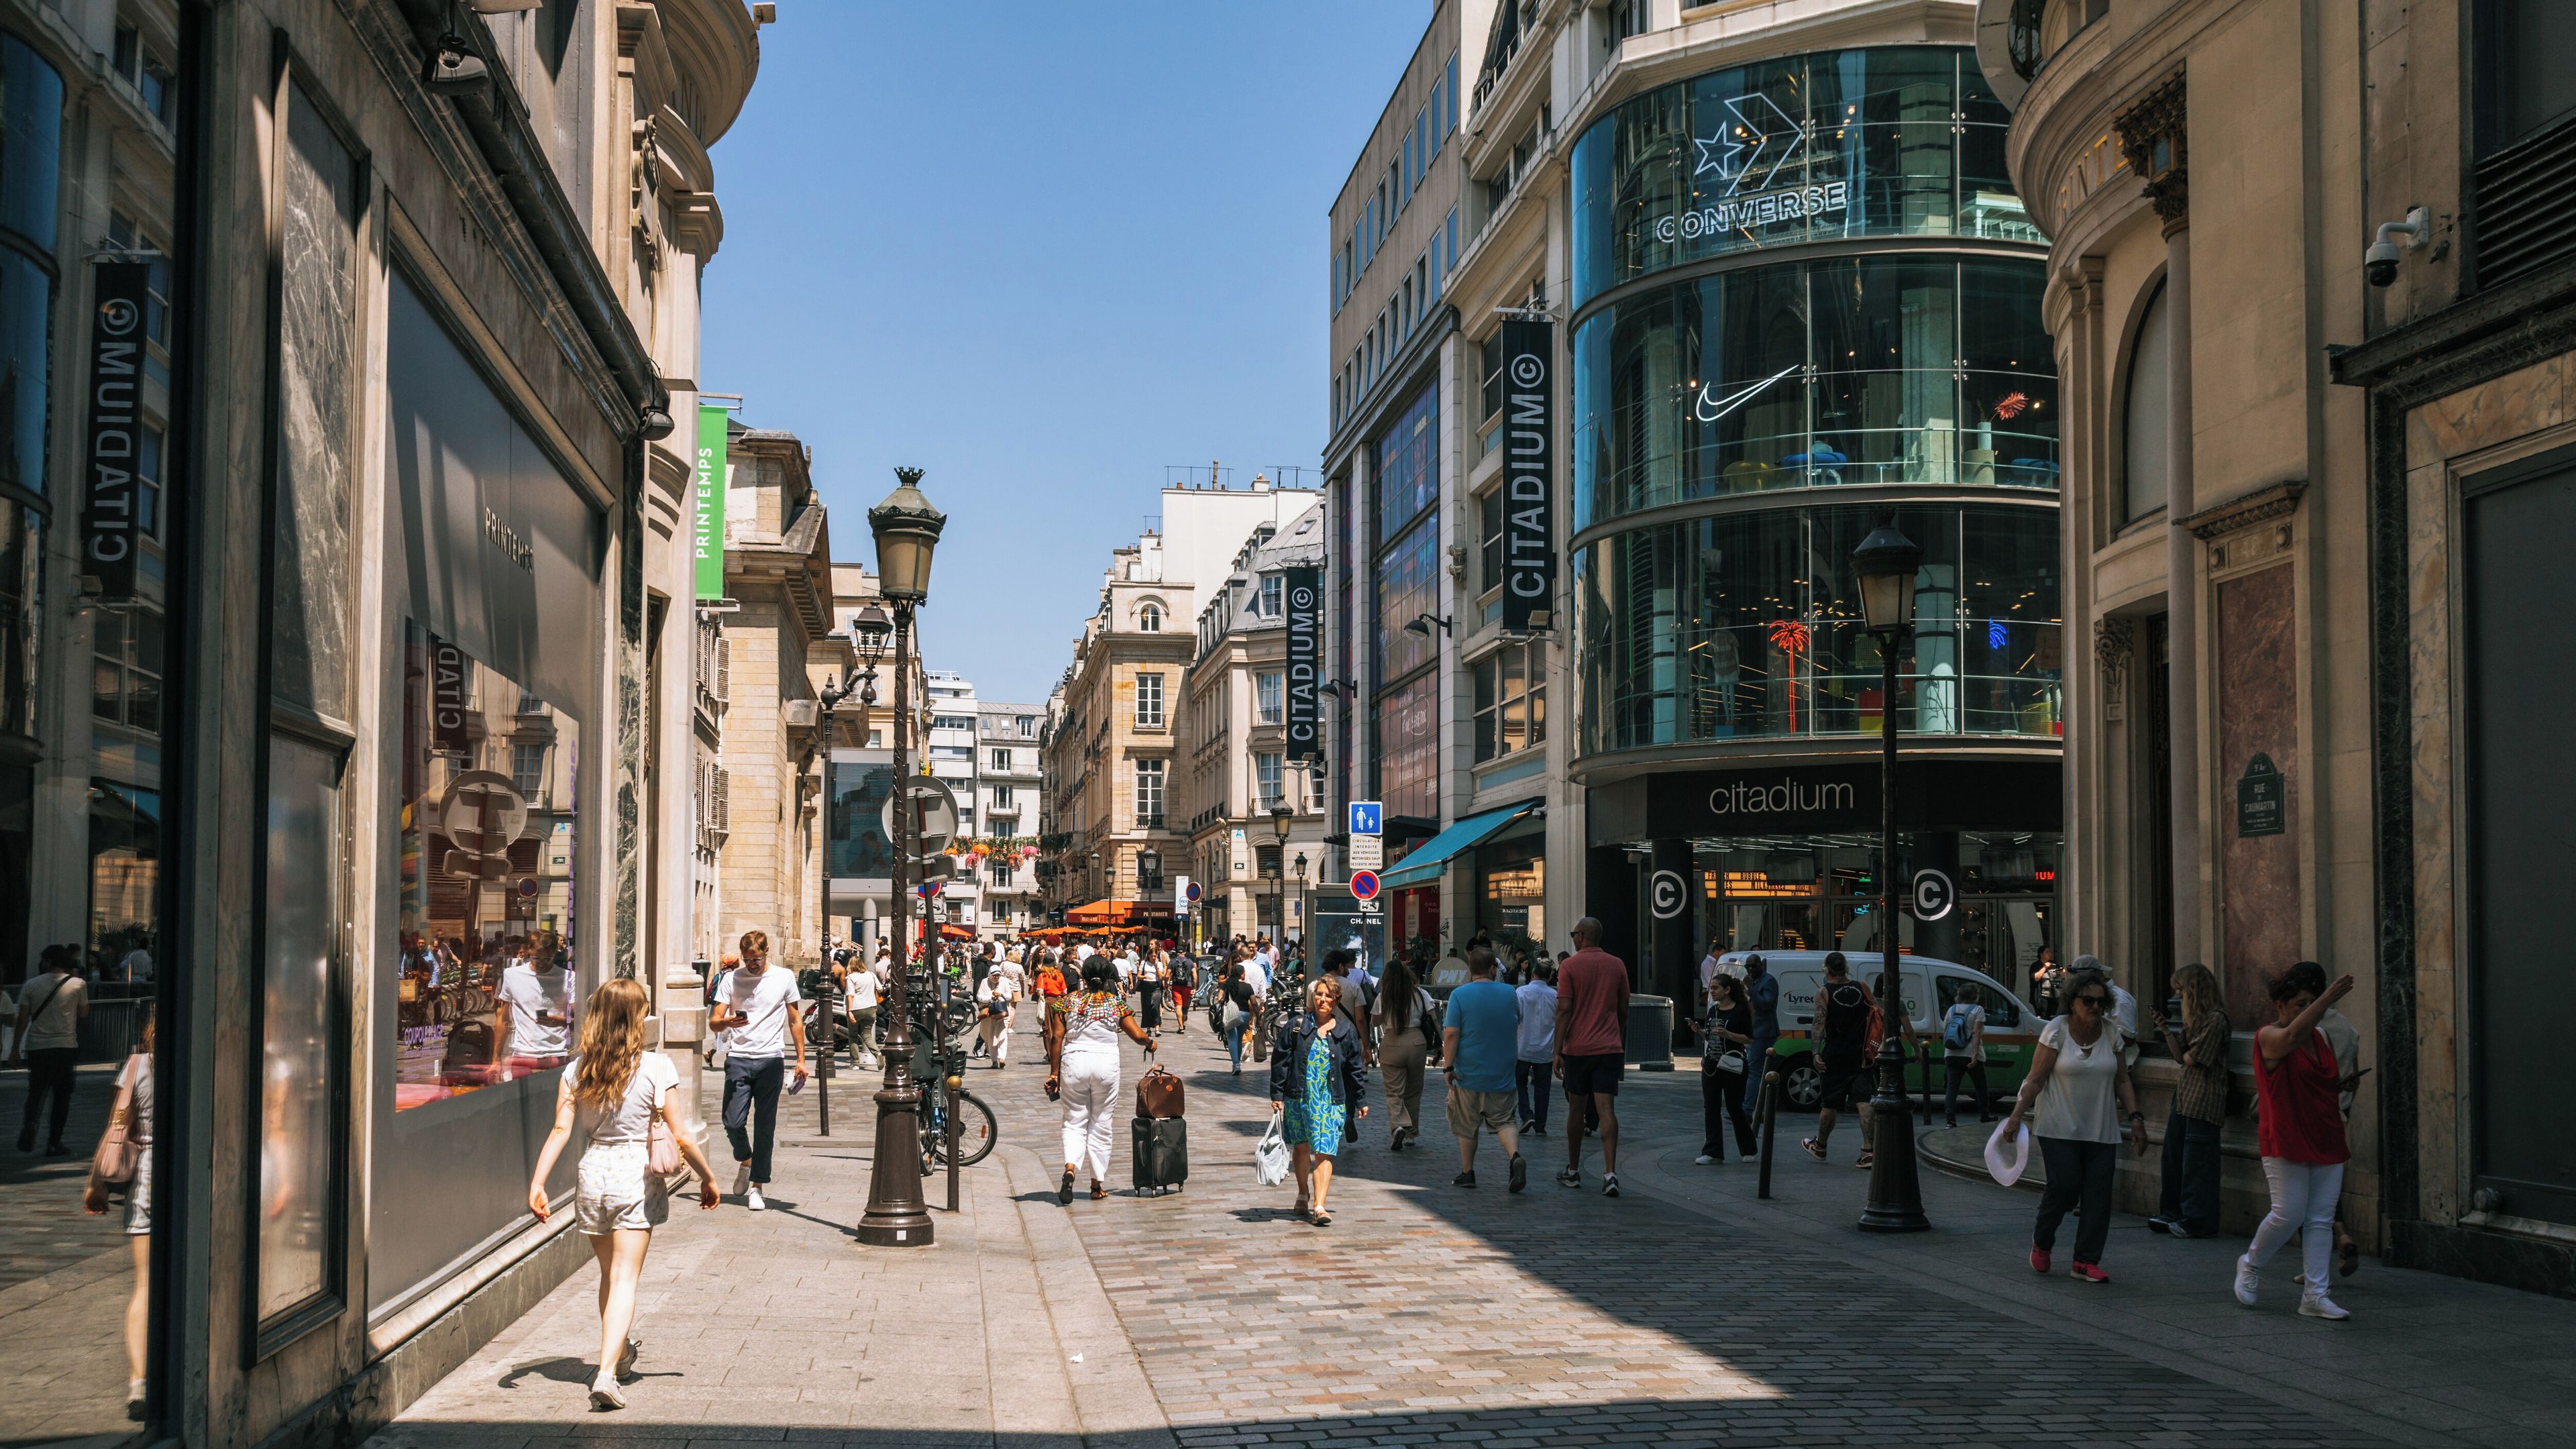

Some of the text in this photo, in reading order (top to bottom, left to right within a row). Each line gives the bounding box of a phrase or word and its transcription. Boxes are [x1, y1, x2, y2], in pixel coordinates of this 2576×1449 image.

[1656, 180, 1848, 244] CONVERSE
[695, 447, 713, 559] PRINTEMPS
[1510, 394, 1545, 598] CITADIUM
[484, 506, 533, 576] PRINTEMPS
[1291, 612, 1313, 741] CITADIUM
[1709, 777, 1855, 814] citadium
[2244, 800, 2276, 813] CAUMARTIN
[2254, 783, 2265, 794] RUE
[1740, 872, 1762, 880] BUBBLE
[1437, 969, 1468, 984] PNY
[1788, 993, 1815, 1004] Lyrec
